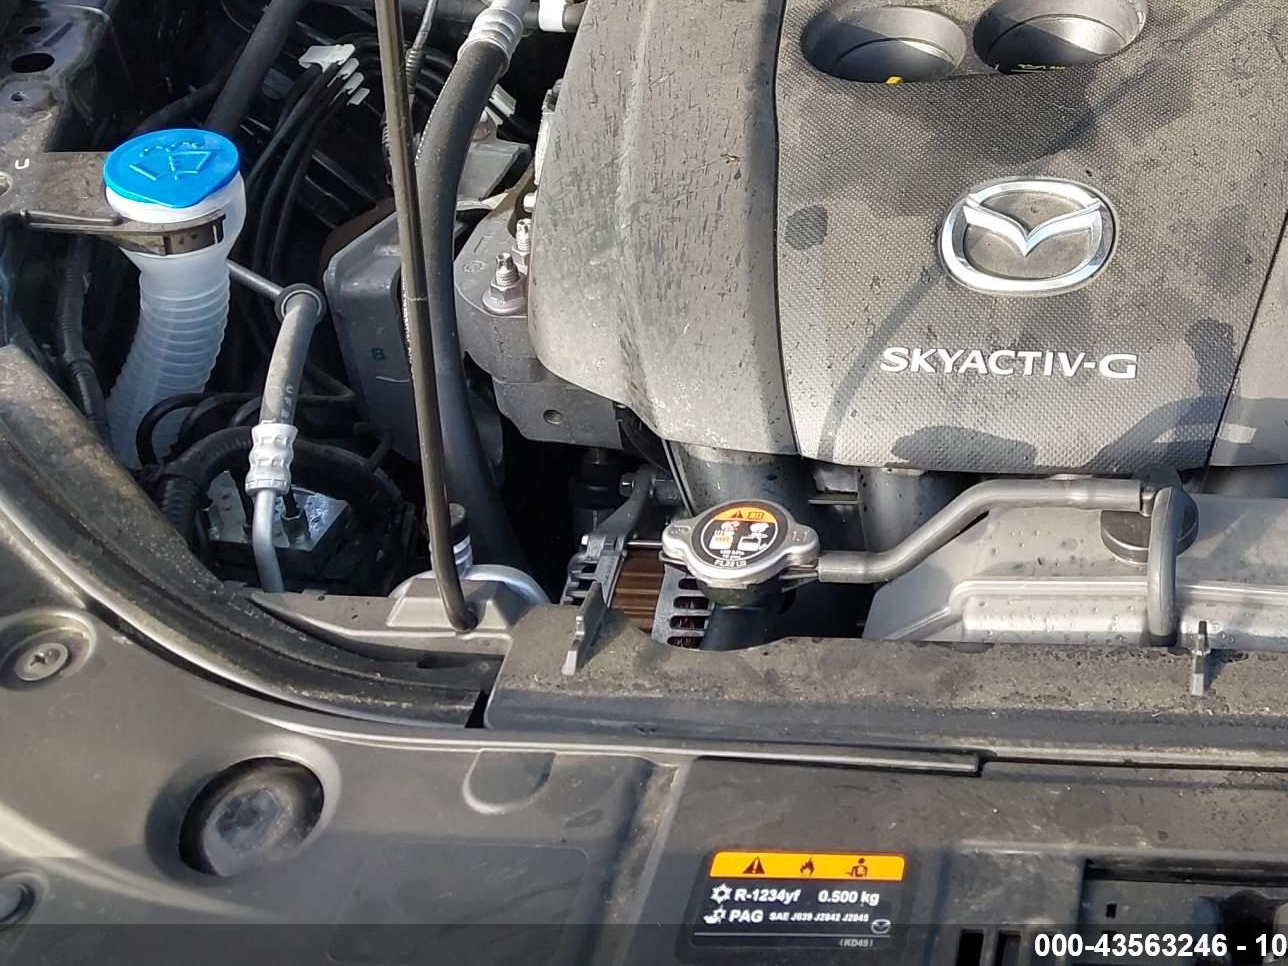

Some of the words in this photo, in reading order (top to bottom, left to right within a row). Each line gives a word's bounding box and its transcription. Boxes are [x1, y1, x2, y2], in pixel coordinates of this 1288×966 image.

[880, 346, 1138, 380] SKYACTIV-G
[734, 887, 801, 905] R-1234yf
[817, 889, 859, 904] 0.500
[860, 891, 880, 906] kg
[729, 909, 764, 924] PAG
[769, 912, 789, 922] SAE
